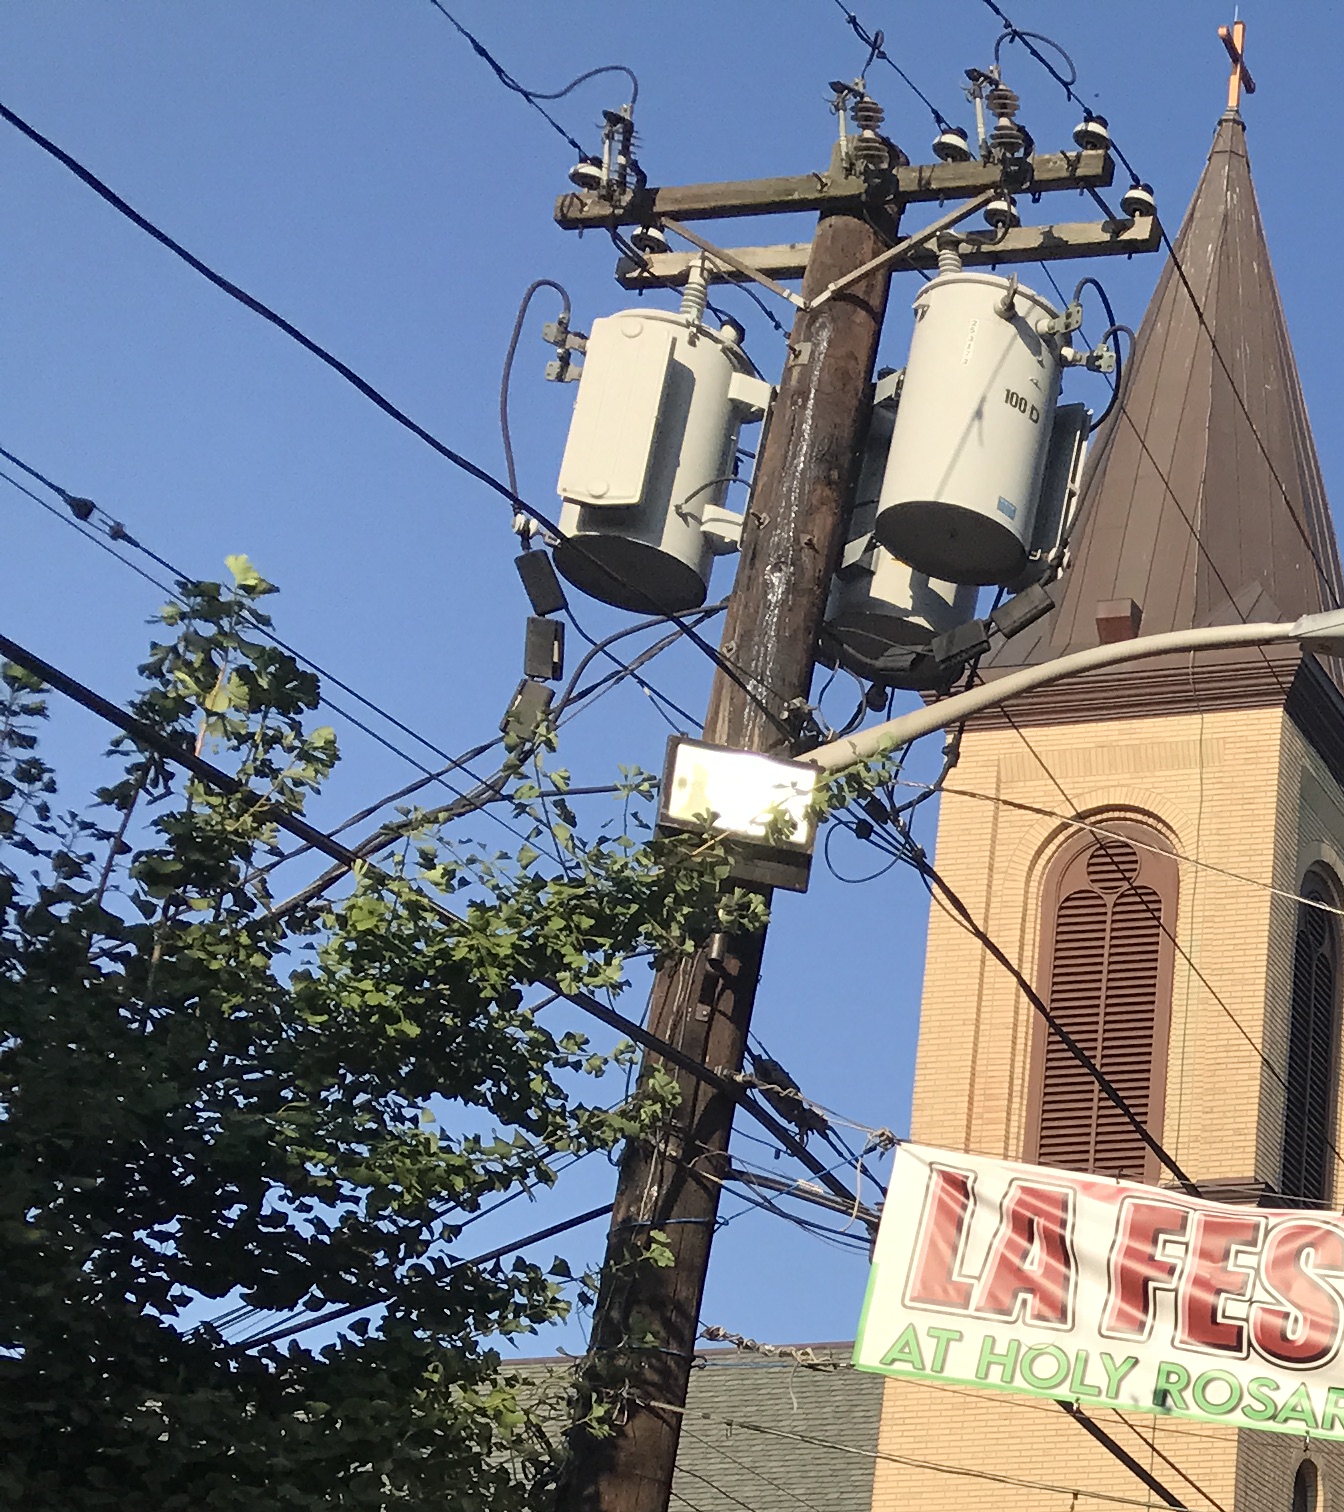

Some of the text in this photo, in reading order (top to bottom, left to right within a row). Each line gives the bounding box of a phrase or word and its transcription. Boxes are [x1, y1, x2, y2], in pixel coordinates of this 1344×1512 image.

[1004, 388, 1040, 424] 100 D
[904, 1162, 1078, 1331] LA
[879, 1323, 963, 1373] AT
[974, 1335, 1138, 1400] HOLY
